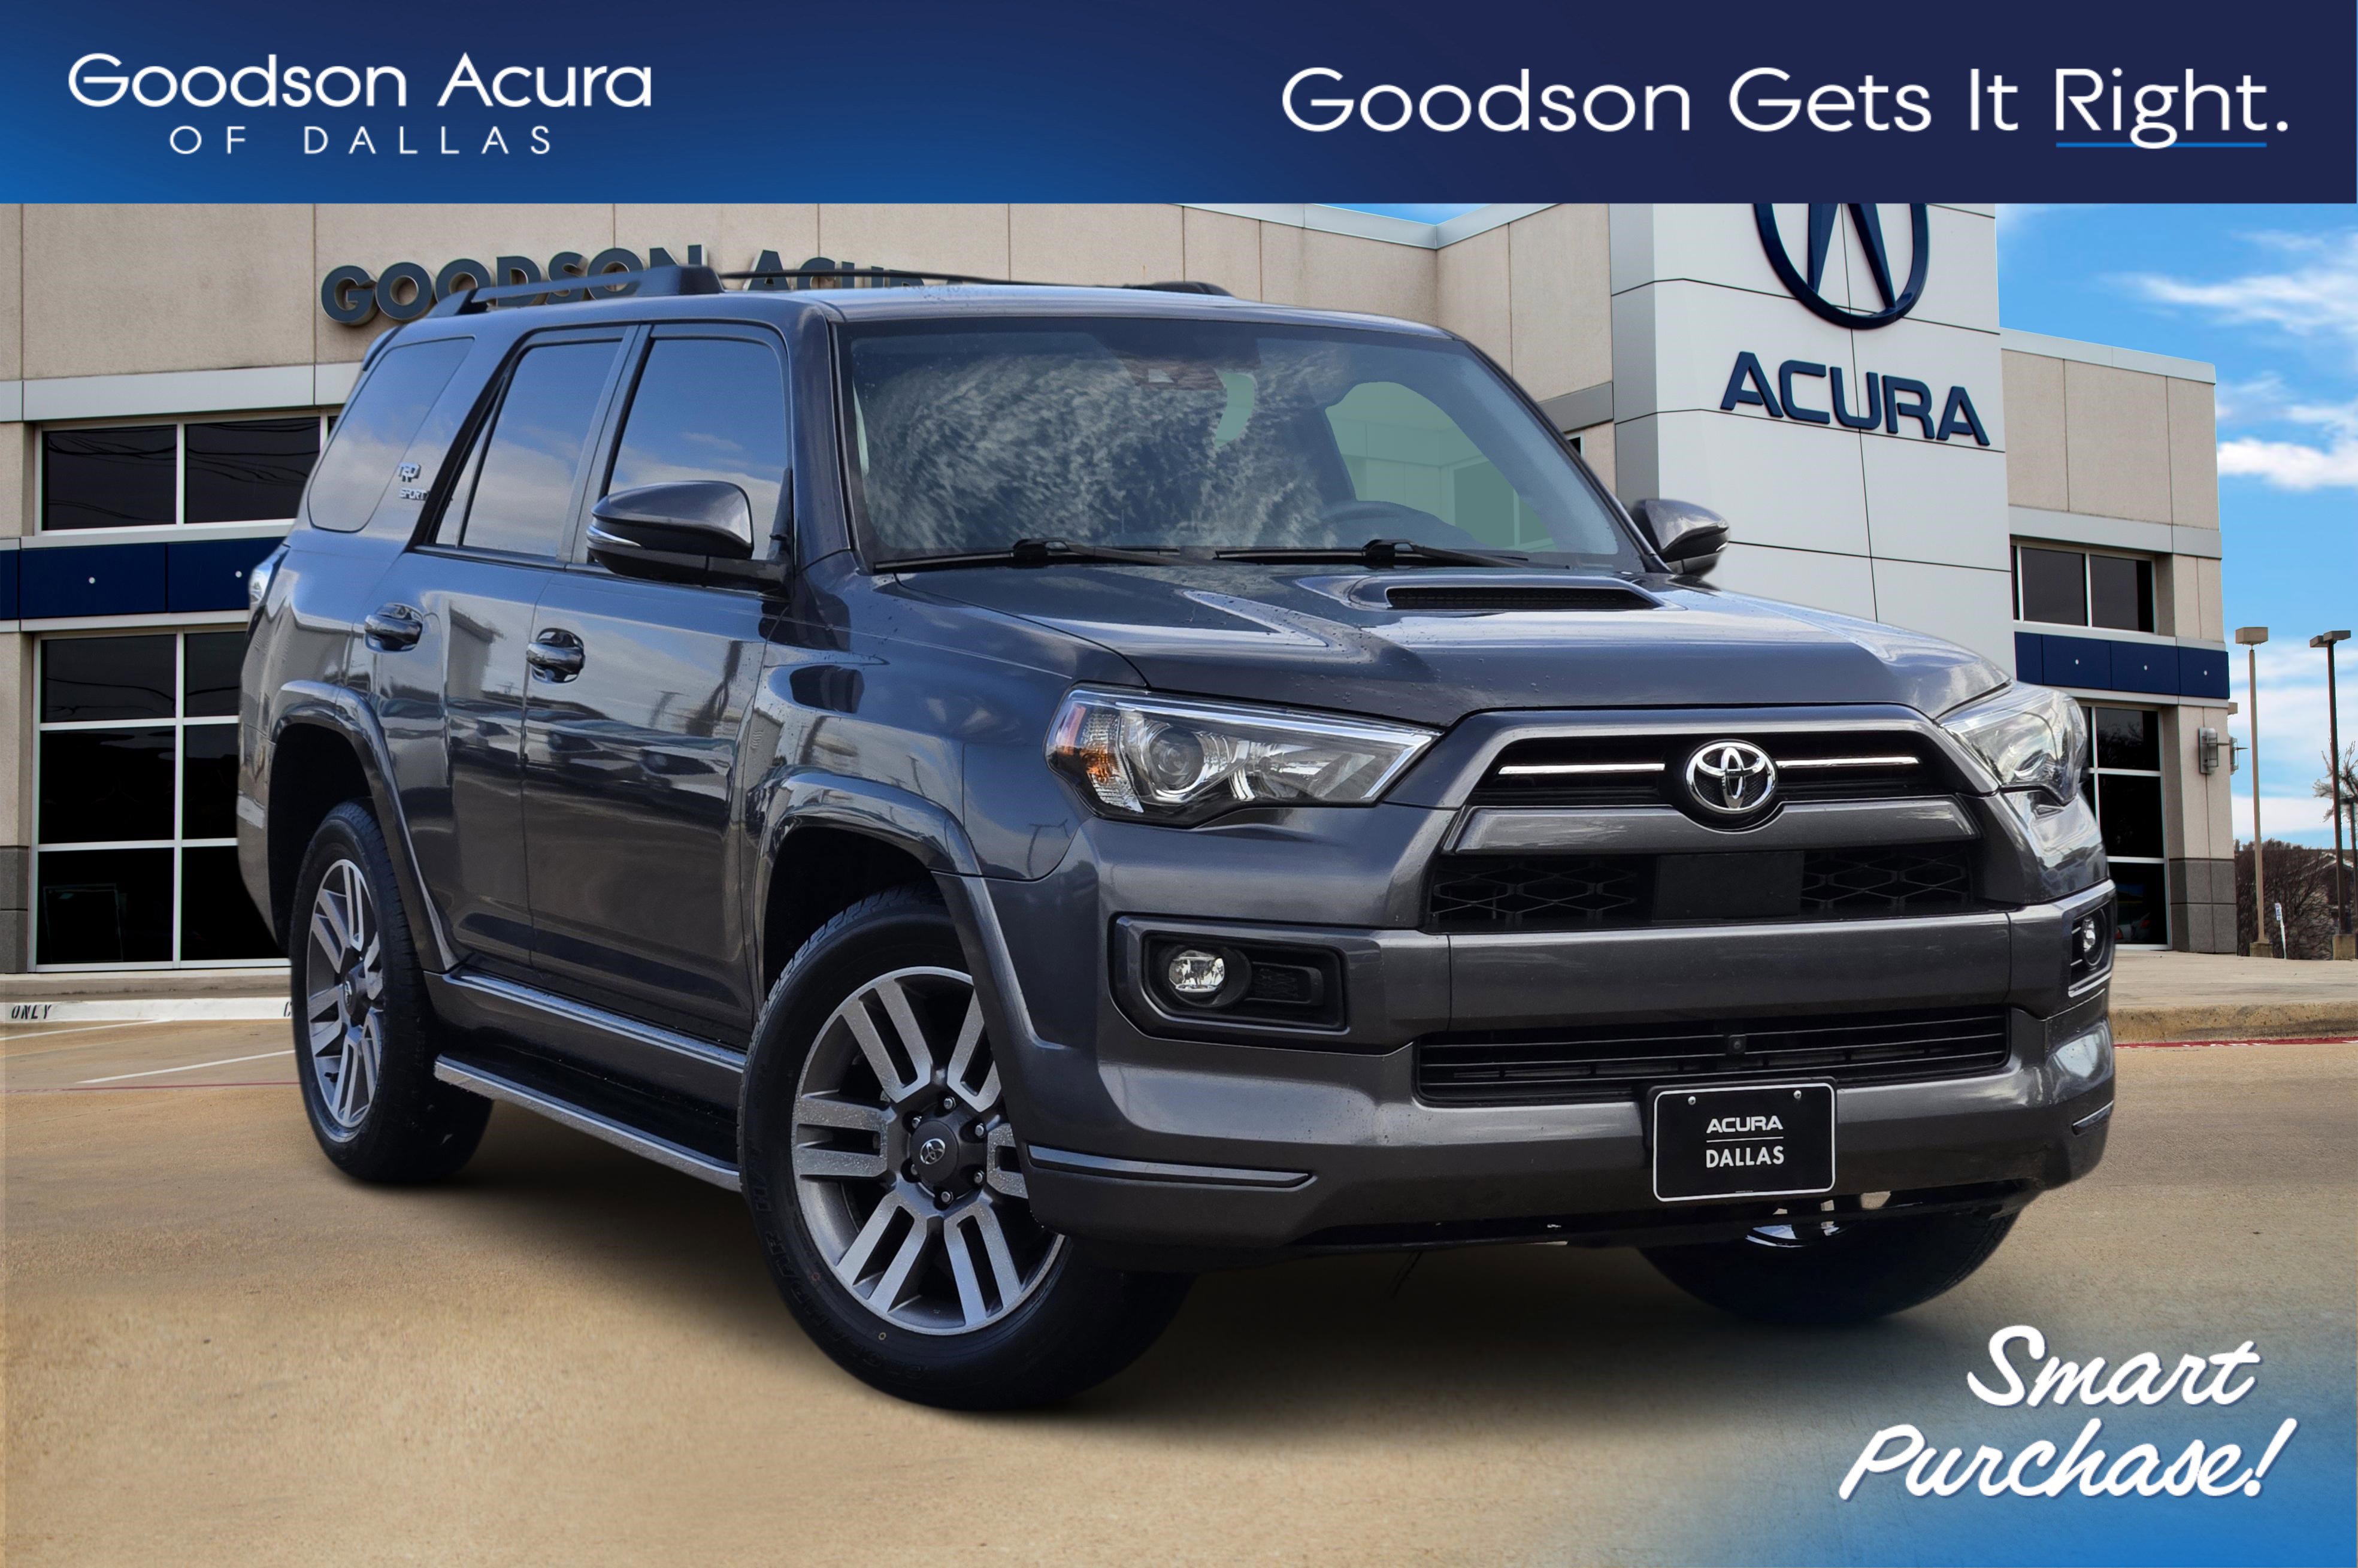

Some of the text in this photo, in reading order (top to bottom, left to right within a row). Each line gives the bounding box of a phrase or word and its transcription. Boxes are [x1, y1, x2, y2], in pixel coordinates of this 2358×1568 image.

[1720, 351, 1990, 446] ACURA
[11, 1004, 52, 1019] ONLY
[1706, 1115, 1784, 1134] ACURA
[1706, 1145, 1785, 1169] DALLAS
